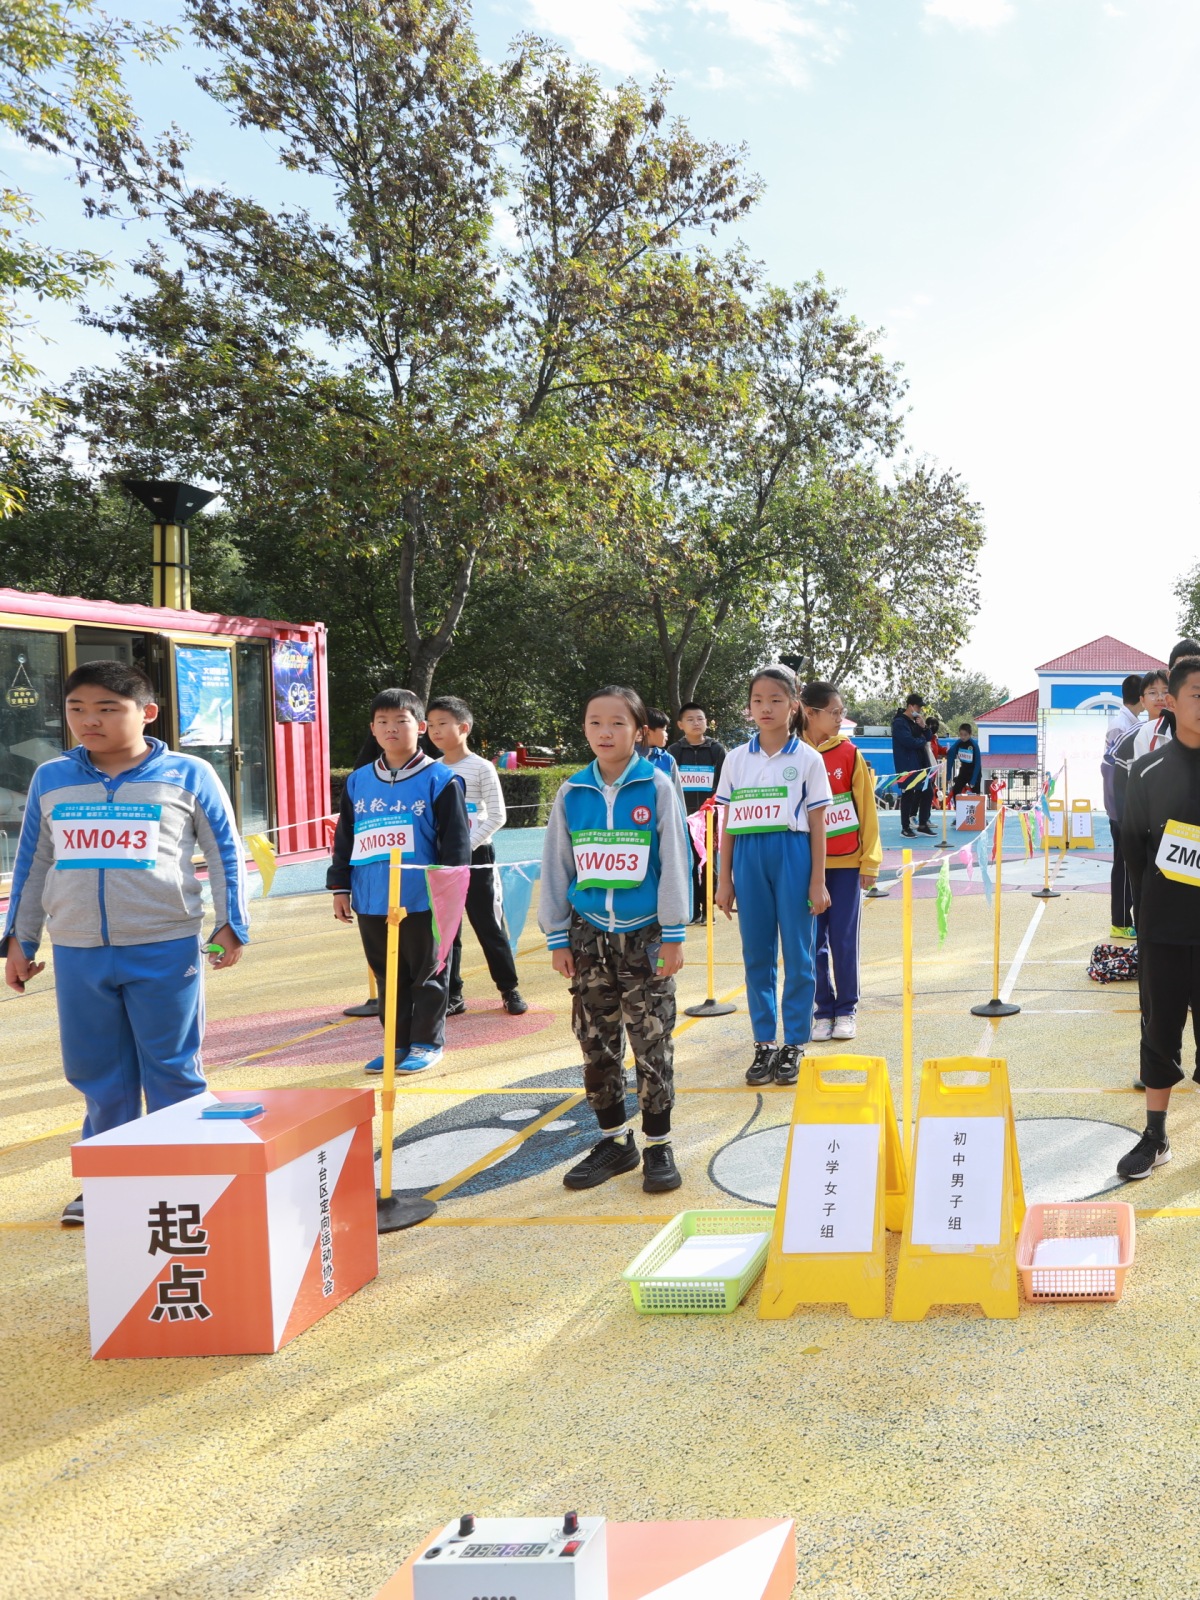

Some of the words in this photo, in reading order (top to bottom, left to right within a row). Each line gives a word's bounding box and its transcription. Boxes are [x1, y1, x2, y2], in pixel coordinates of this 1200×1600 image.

[680, 775, 710, 784] XM061
[354, 798, 426, 816] 扶轮小学
[734, 805, 781, 821] XW017
[62, 828, 148, 850] XM043
[359, 832, 407, 853] XM038
[576, 851, 639, 872] XW053
[820, 1138, 840, 1239] 小学女子组
[947, 1131, 967, 1231] 初中男子组
[317, 1150, 333, 1297] 丰台区定向运动协会
[147, 1201, 212, 1321] 起点
